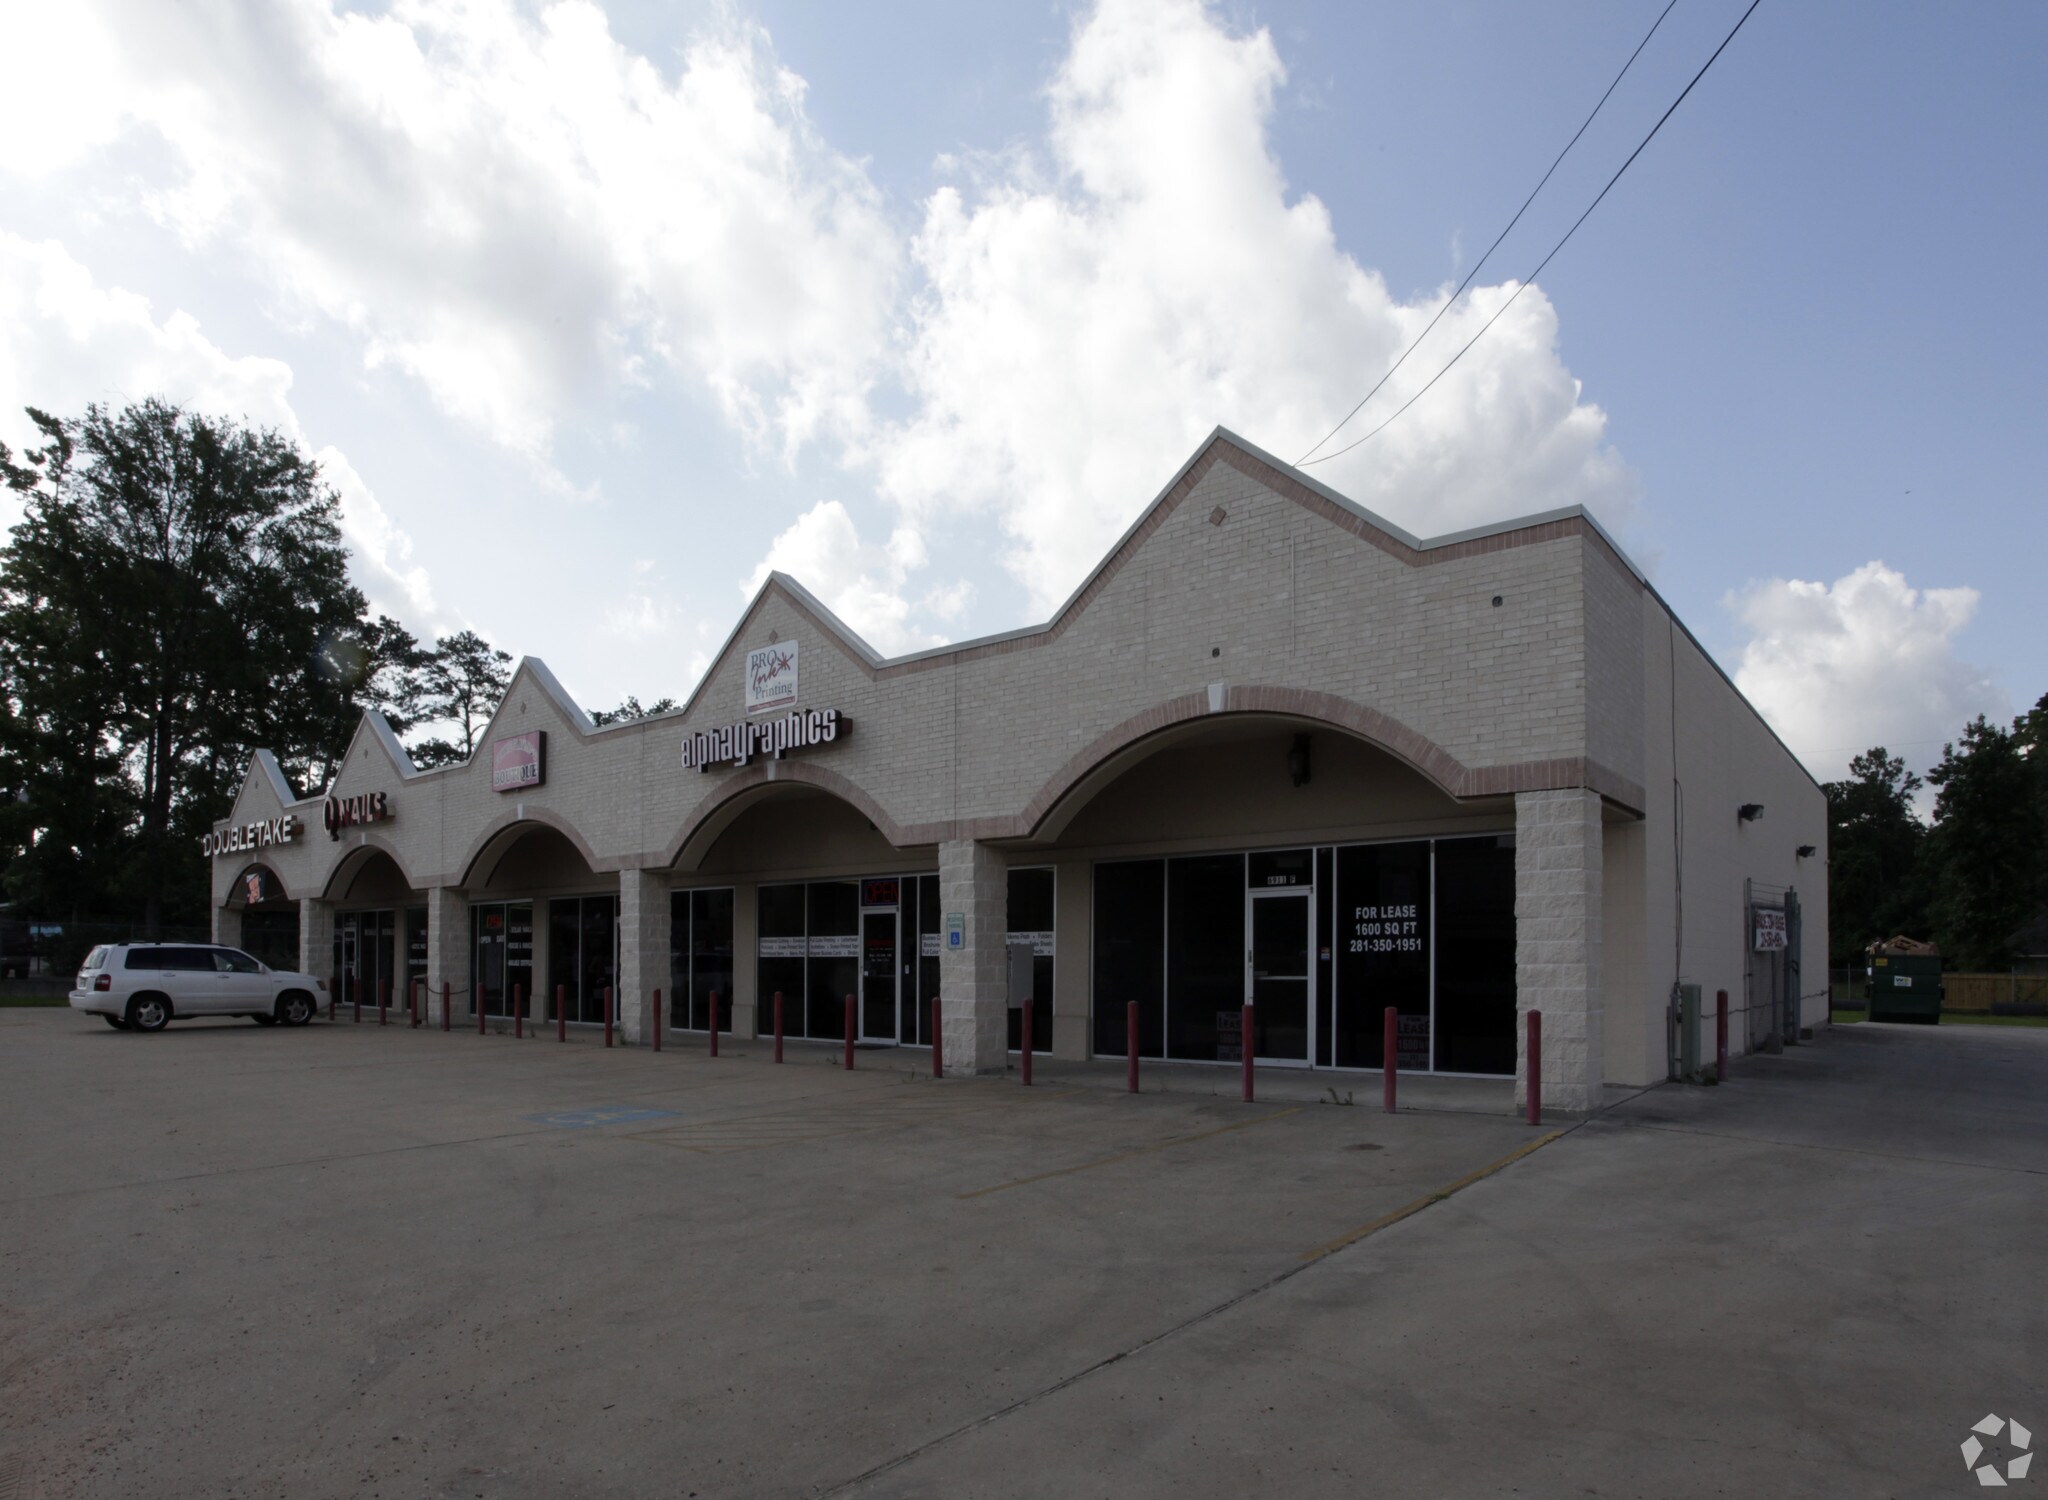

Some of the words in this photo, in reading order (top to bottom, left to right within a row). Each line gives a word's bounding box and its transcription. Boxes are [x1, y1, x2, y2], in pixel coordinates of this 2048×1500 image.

[751, 650, 777, 669] PRO
[751, 658, 780, 691] Ink
[756, 682, 792, 699] Printing
[681, 708, 838, 772] alphagraphics
[495, 764, 537, 785] BOUTIQUE
[338, 792, 386, 826] NAILS
[1355, 906, 1377, 919] FOR
[1380, 904, 1416, 918] LEASE
[1355, 922, 1381, 935] 1600
[1384, 922, 1399, 935] SQ
[1403, 921, 1417, 934] FT
[1350, 938, 1421, 952] 281-350-1951
